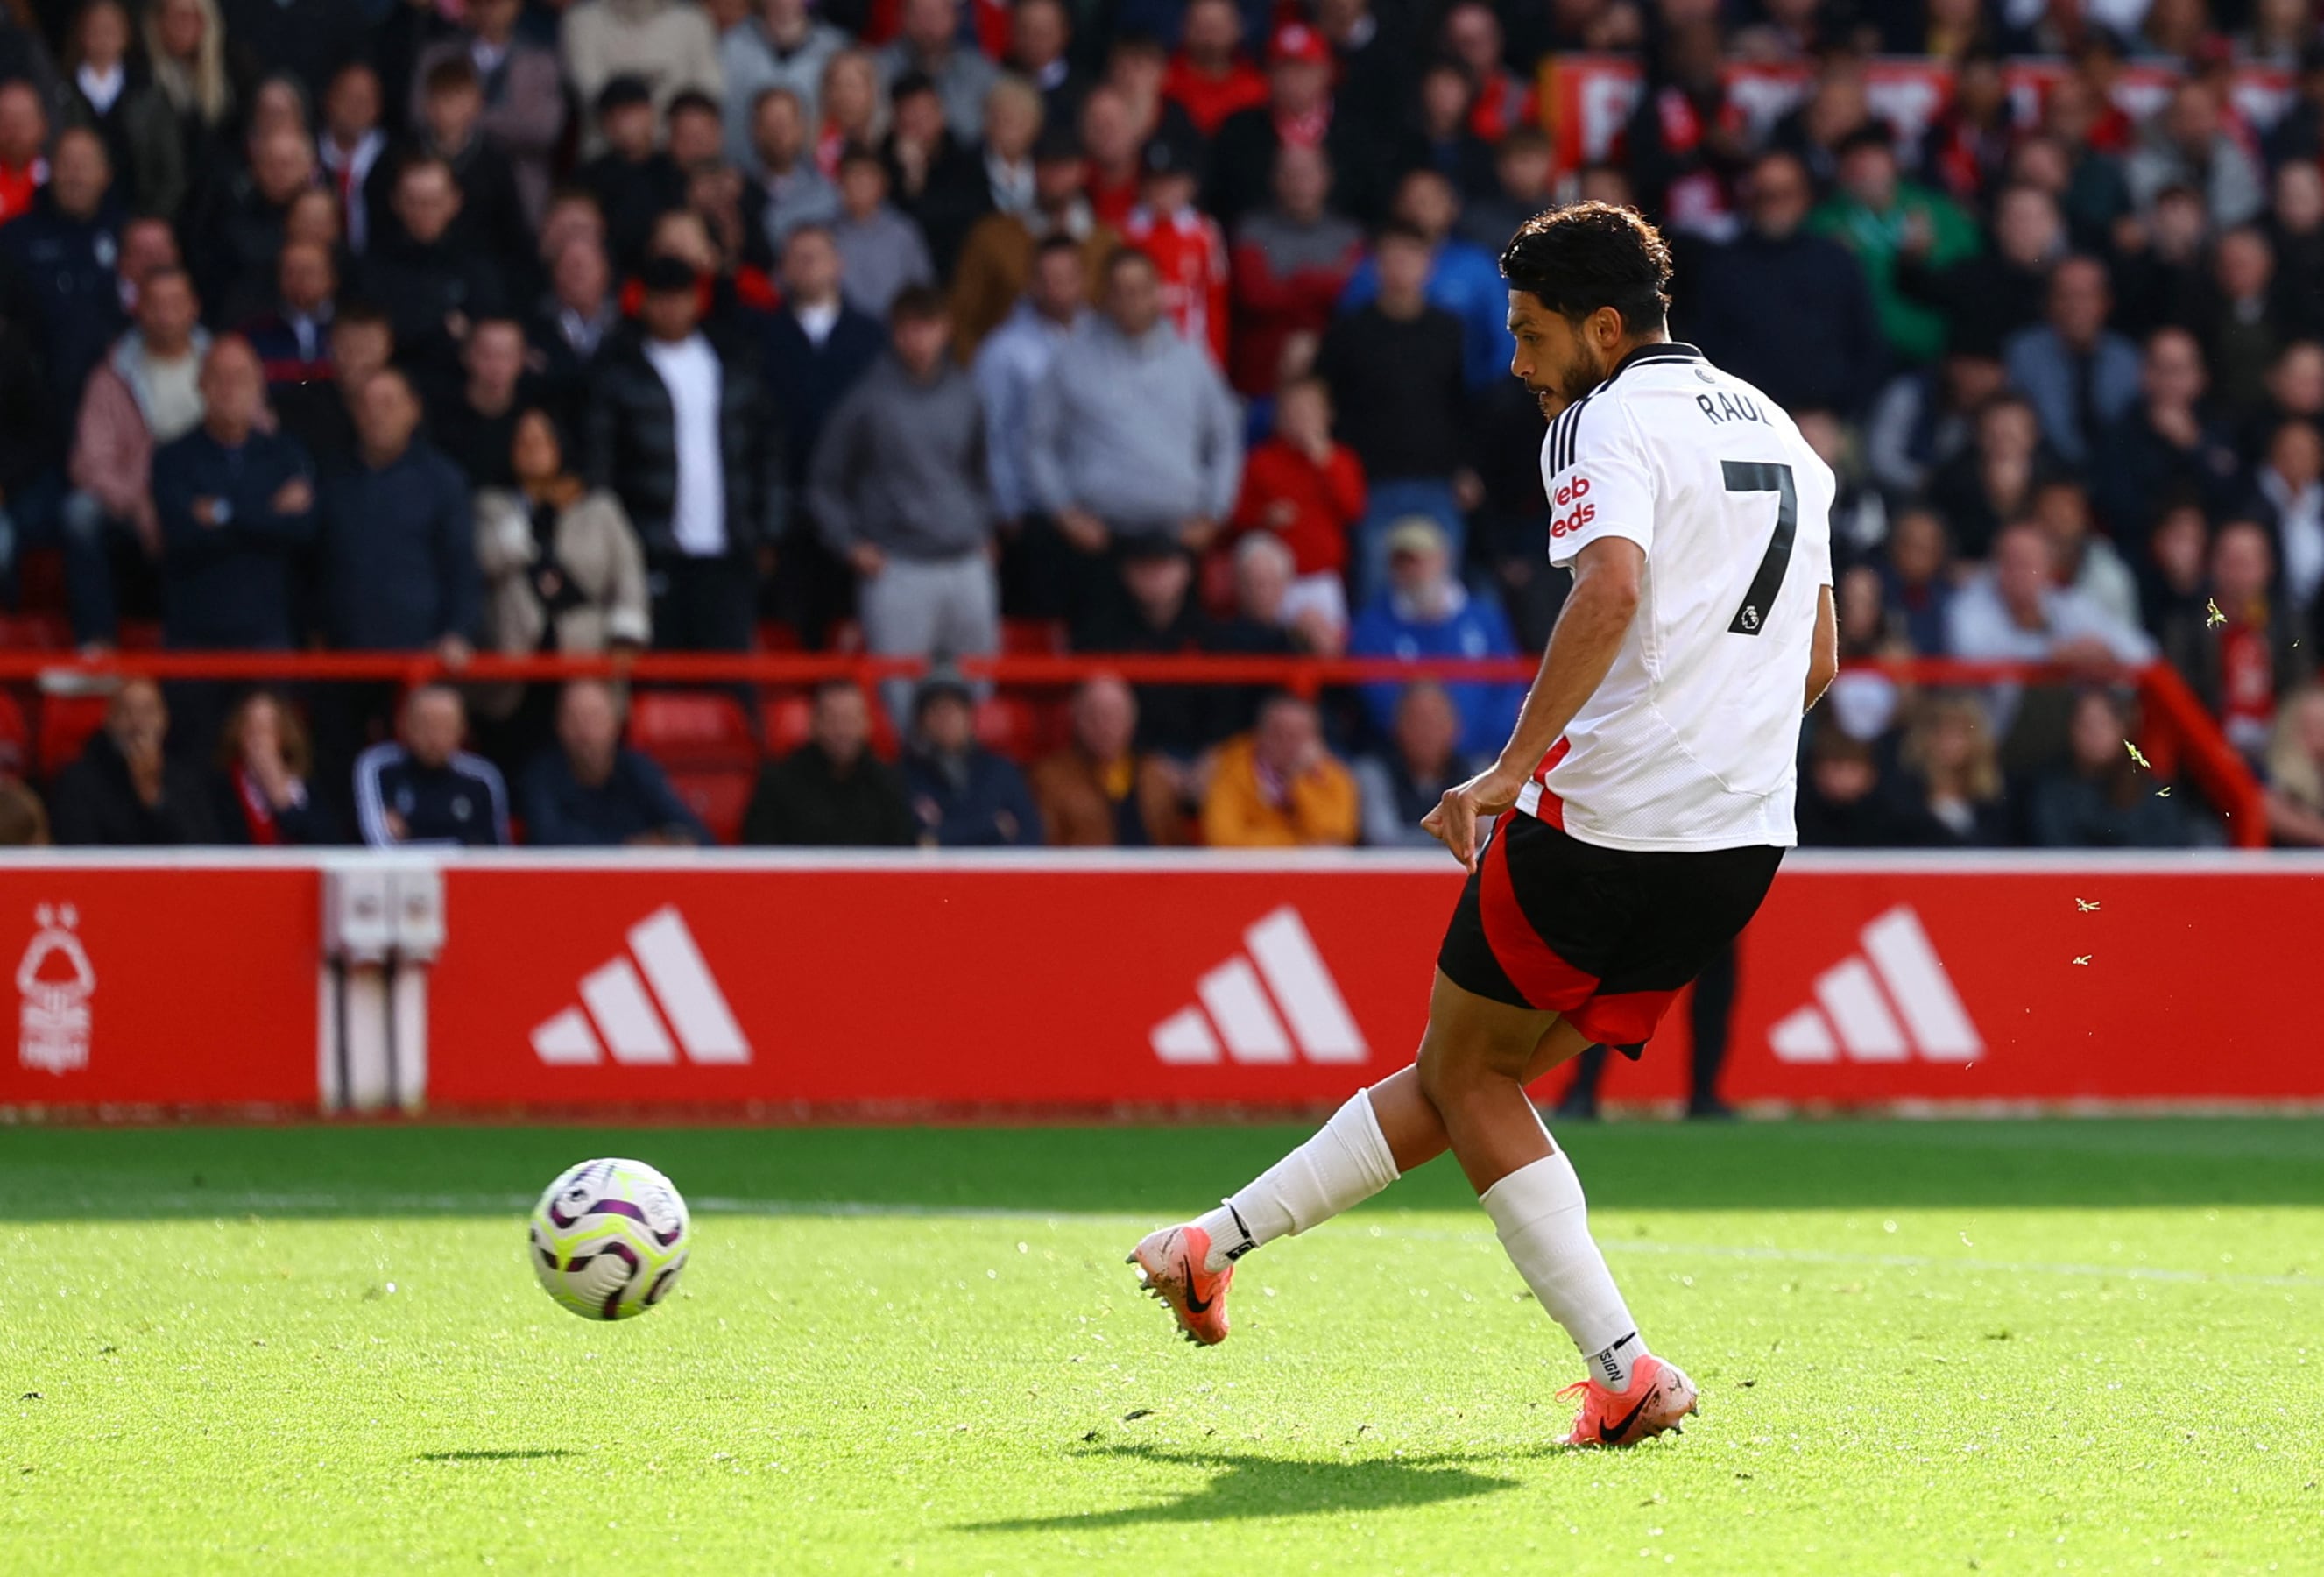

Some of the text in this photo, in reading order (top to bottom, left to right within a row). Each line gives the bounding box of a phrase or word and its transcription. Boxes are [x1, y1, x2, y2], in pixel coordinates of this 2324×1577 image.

[1696, 392, 1775, 428] RAUL
[1553, 475, 1590, 509] eb
[1551, 502, 1595, 539] eds
[1720, 460, 1798, 636] 7
[1600, 1349, 1624, 1383] SIGN
